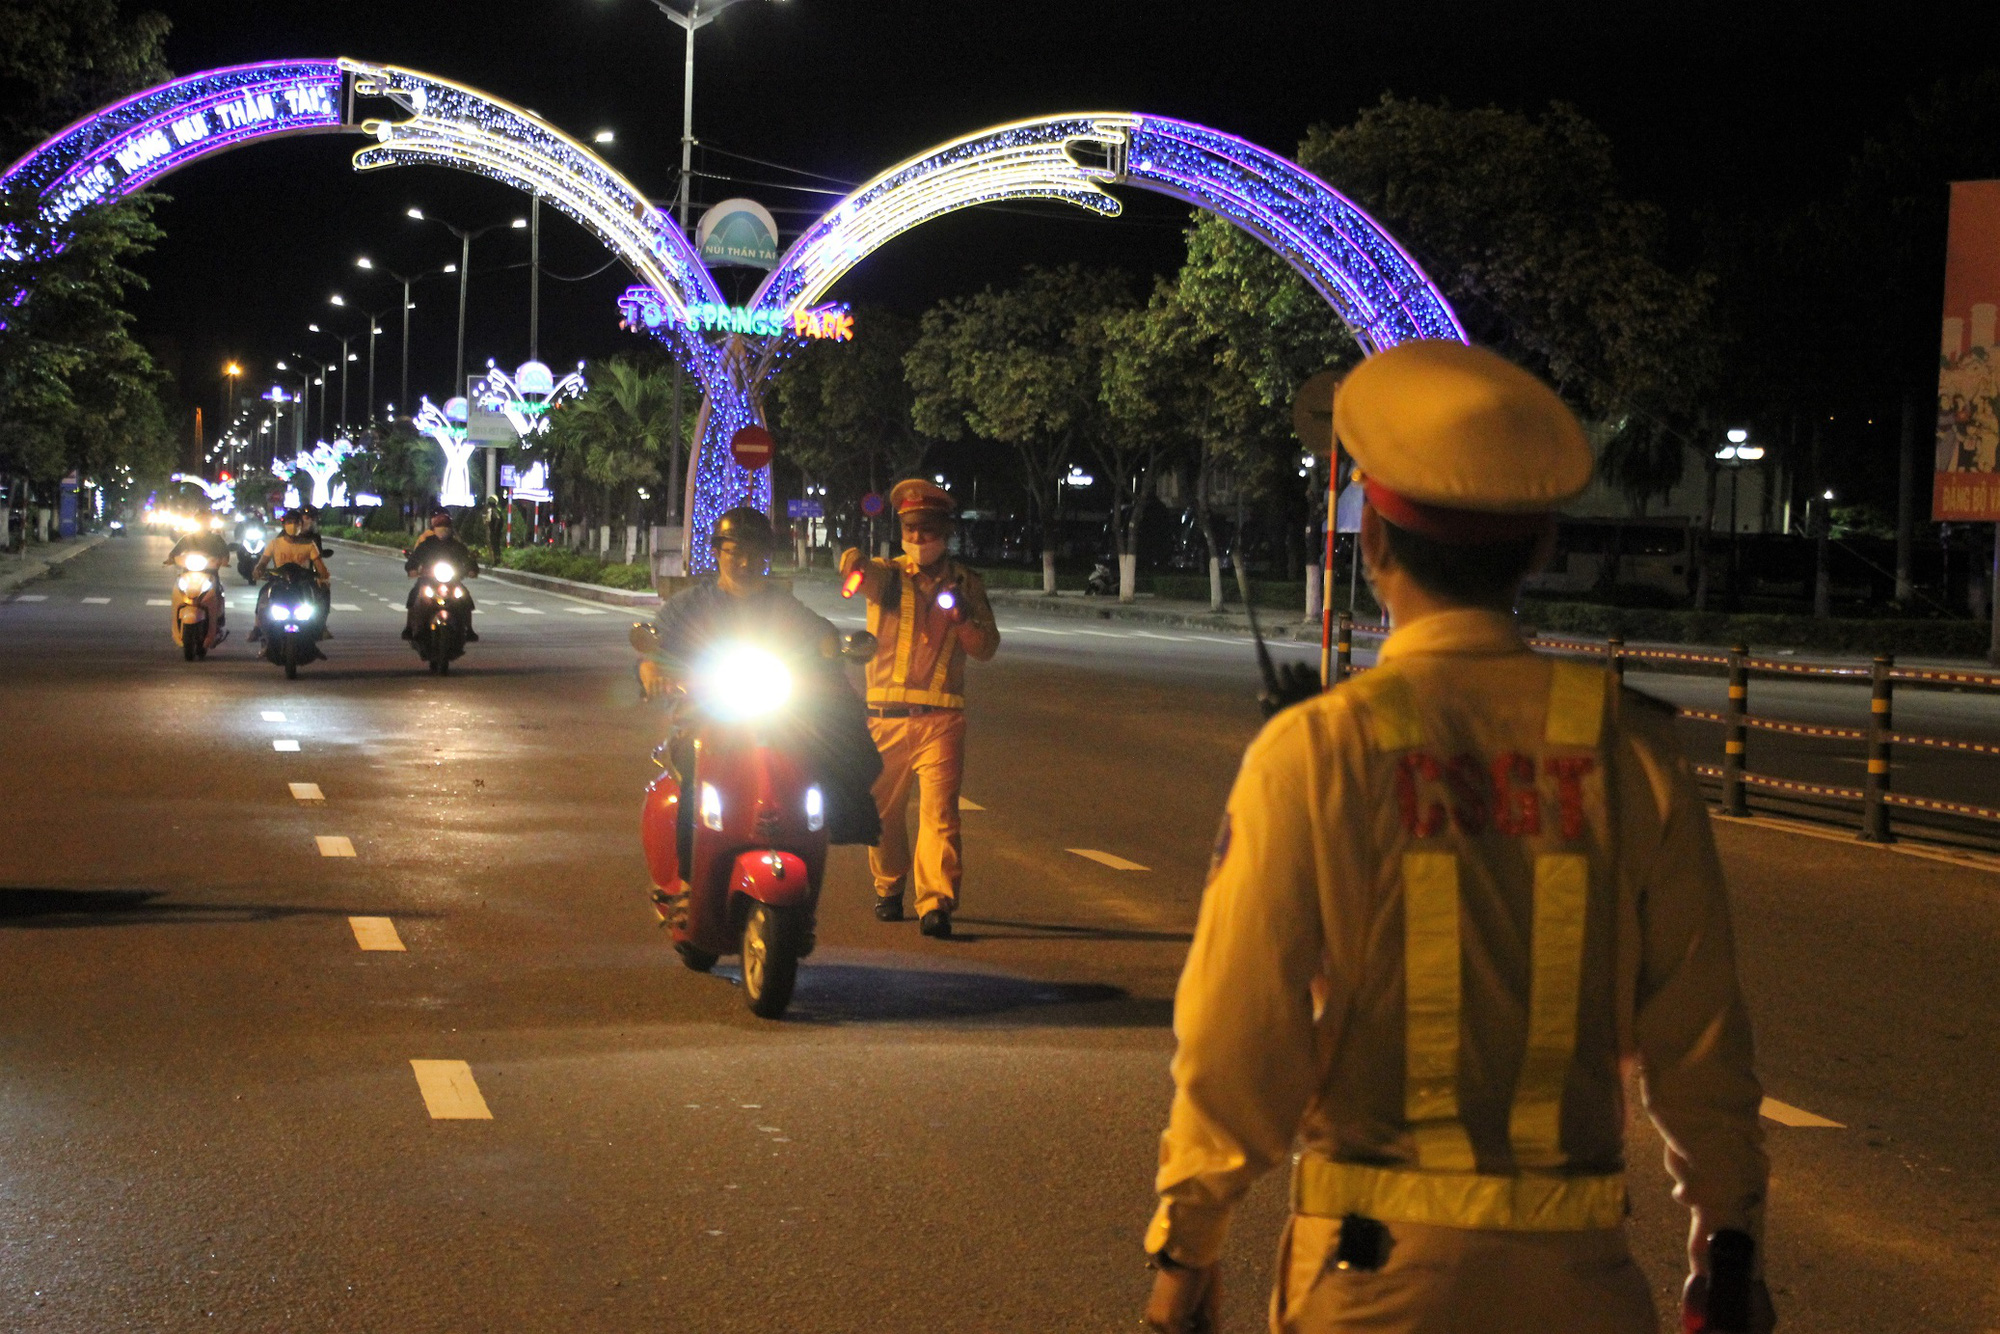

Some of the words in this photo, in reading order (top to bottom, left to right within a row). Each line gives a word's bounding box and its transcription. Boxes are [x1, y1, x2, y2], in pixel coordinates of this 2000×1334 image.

[685, 303, 784, 337] SPRINGS
[794, 309, 854, 341] PARK
[1395, 752, 1596, 840] CSGT
